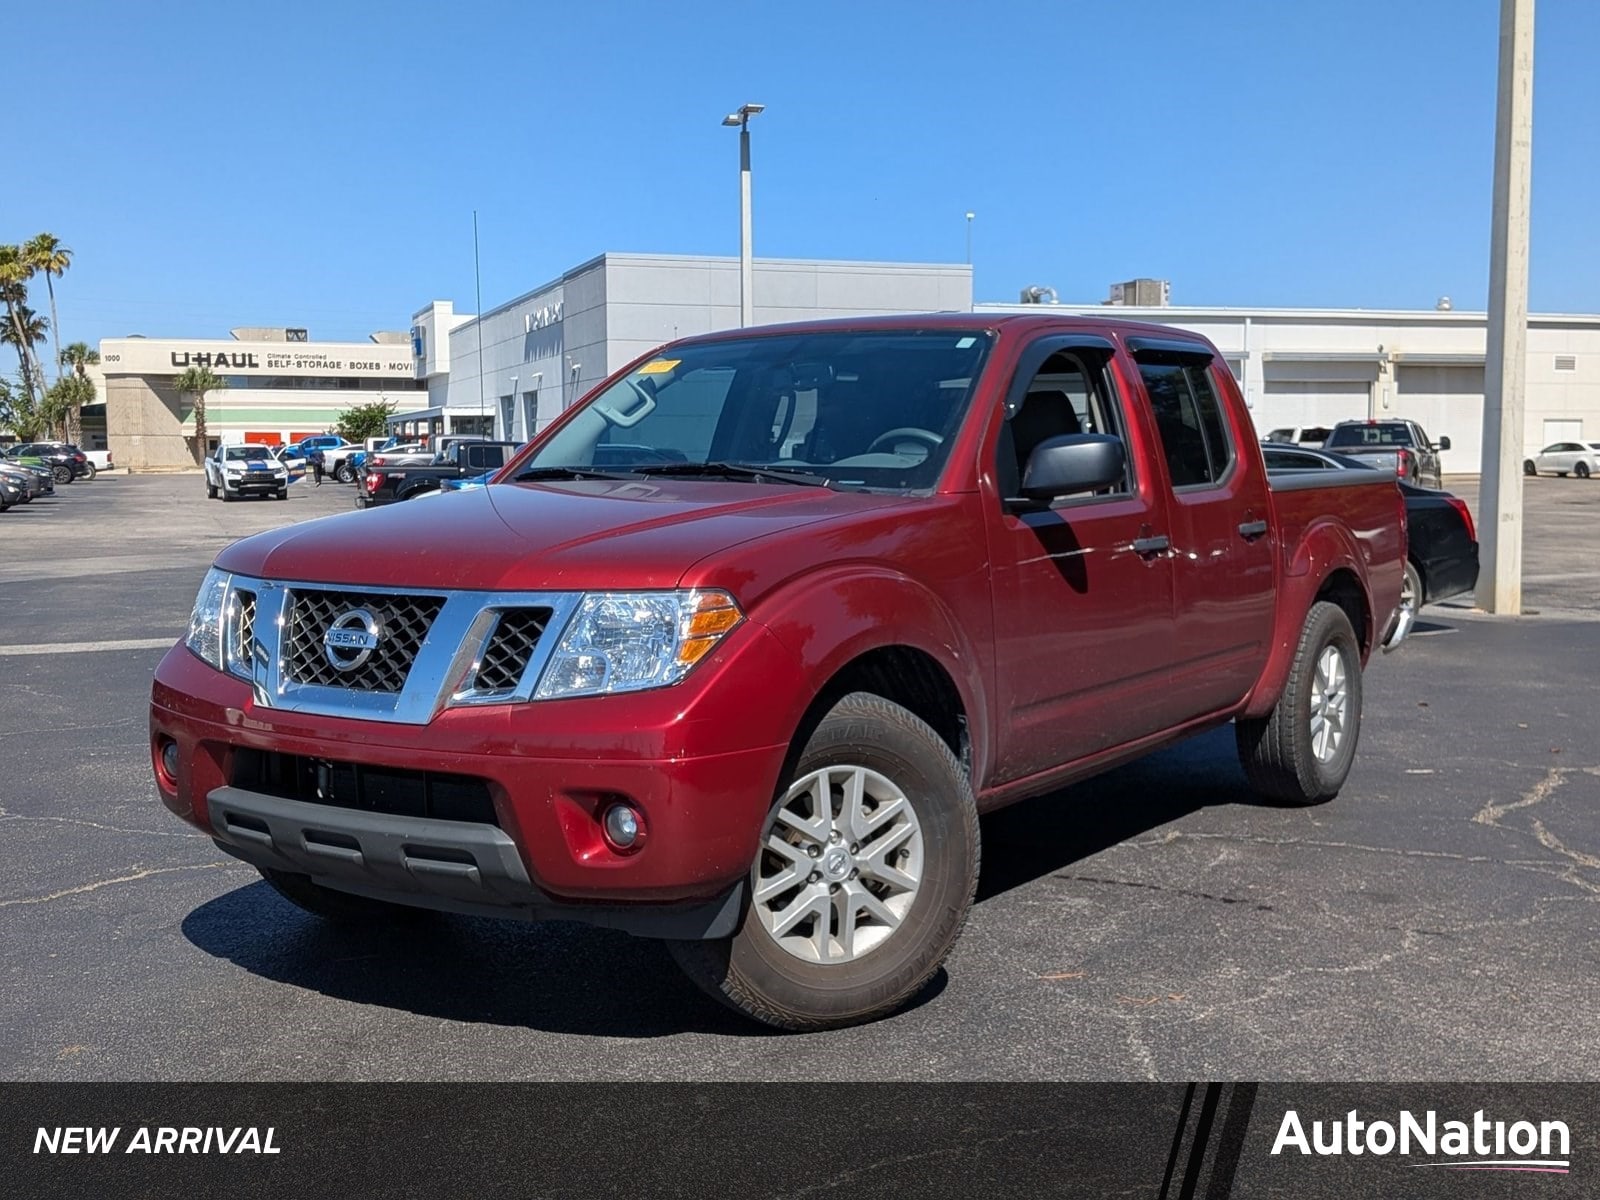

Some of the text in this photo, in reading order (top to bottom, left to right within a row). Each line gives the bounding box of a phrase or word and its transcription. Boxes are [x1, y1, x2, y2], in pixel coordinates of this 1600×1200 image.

[104, 354, 121, 362] 1000
[171, 351, 260, 368] U-HAUL
[266, 352, 327, 361] Climate Controlled
[349, 361, 381, 371] BOXES
[388, 362, 413, 371] MOVI
[328, 632, 369, 646] NISSAN
